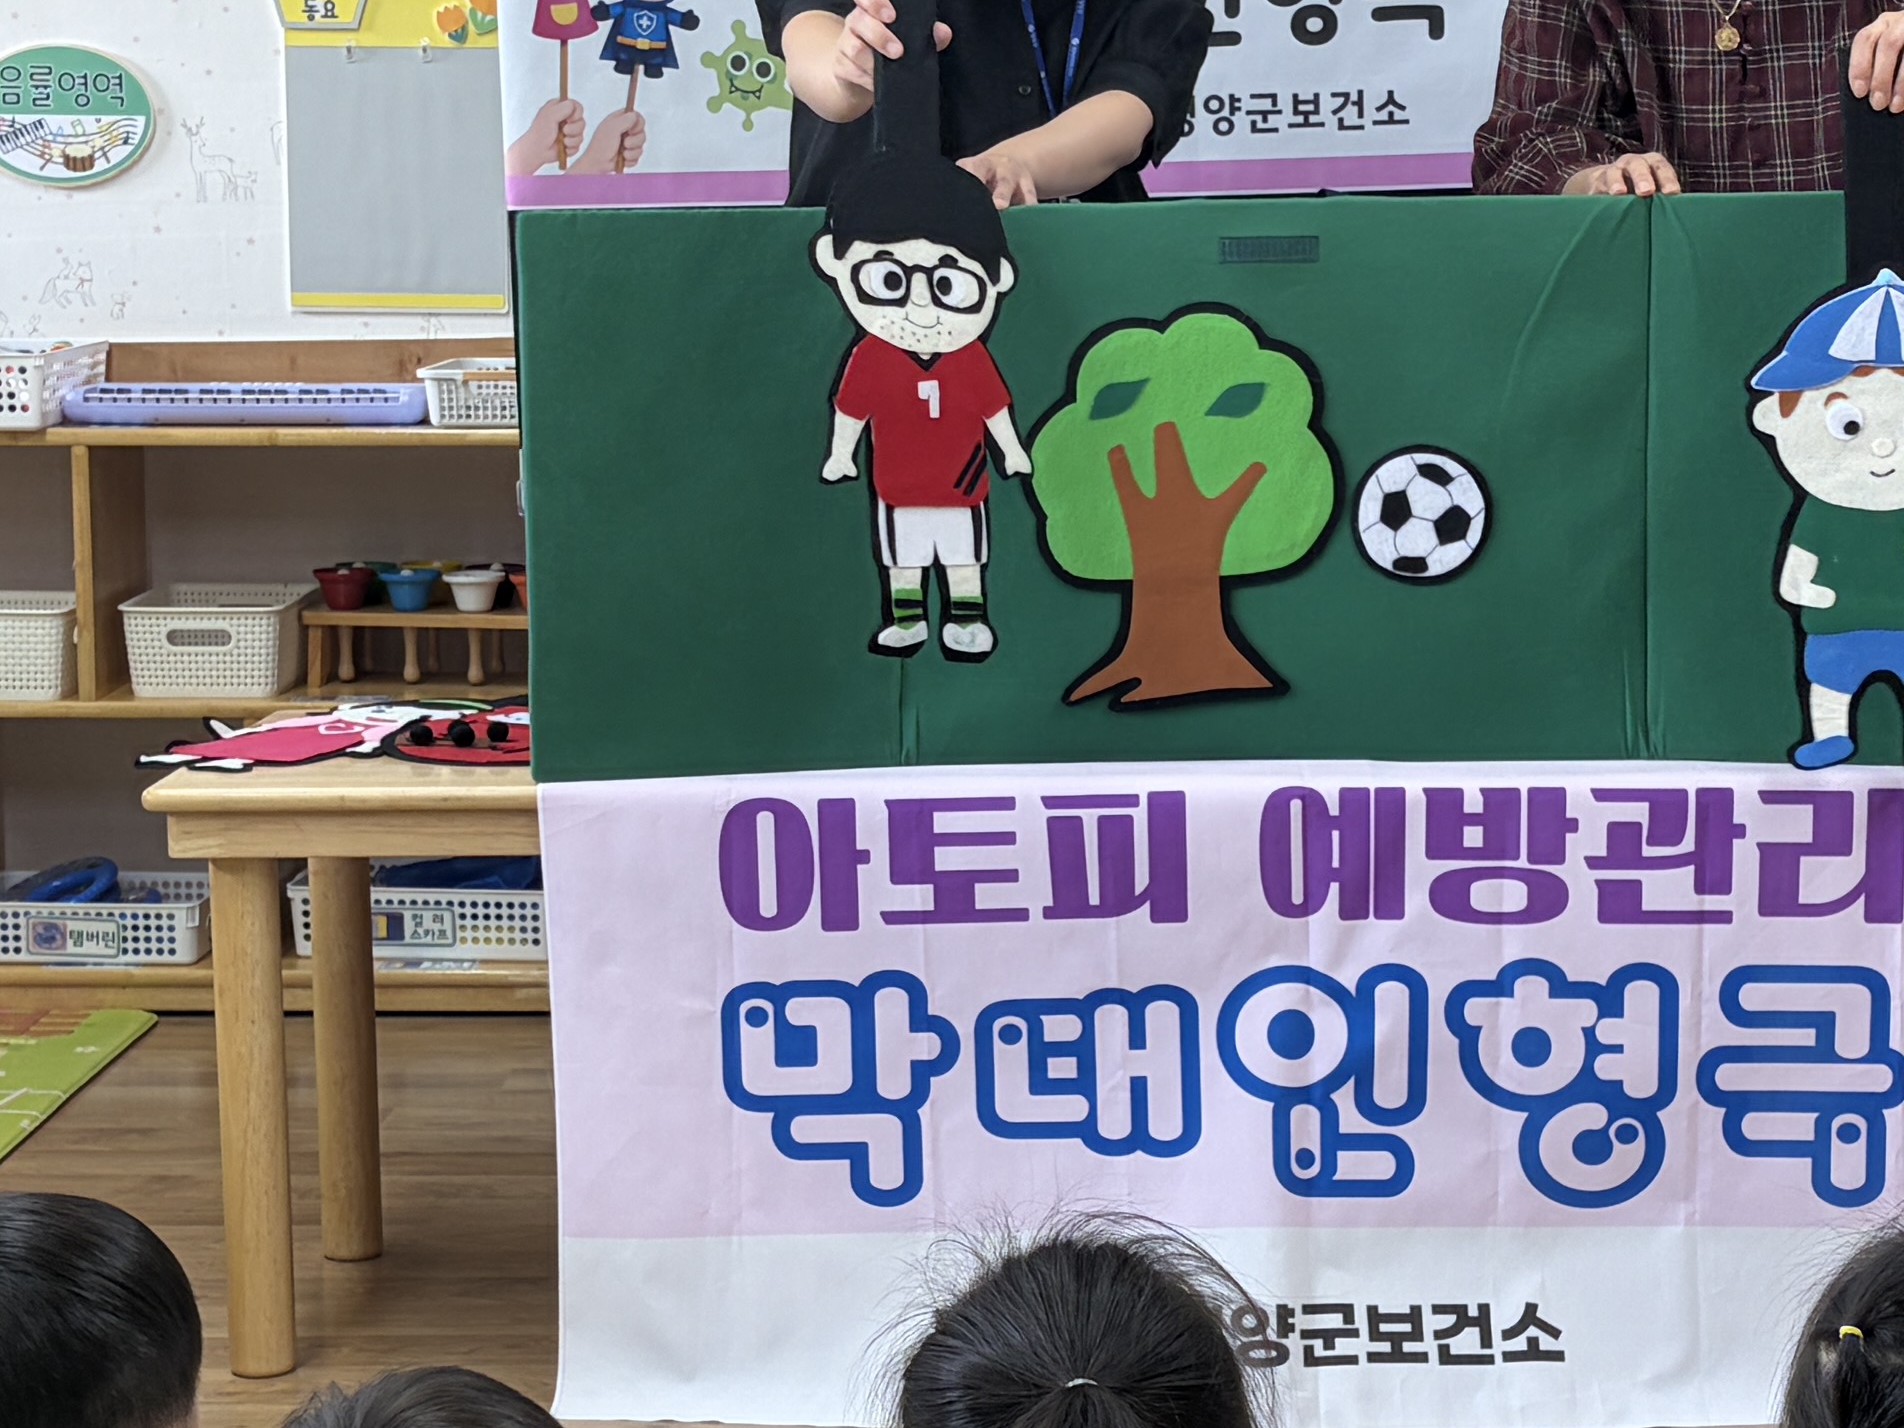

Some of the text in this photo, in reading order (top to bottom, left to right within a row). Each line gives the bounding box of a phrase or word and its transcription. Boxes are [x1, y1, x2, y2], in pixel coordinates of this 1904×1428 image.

[717, 789, 1188, 933] 아토피
[68, 928, 118, 950] 탬버린
[409, 928, 450, 942] 스카프
